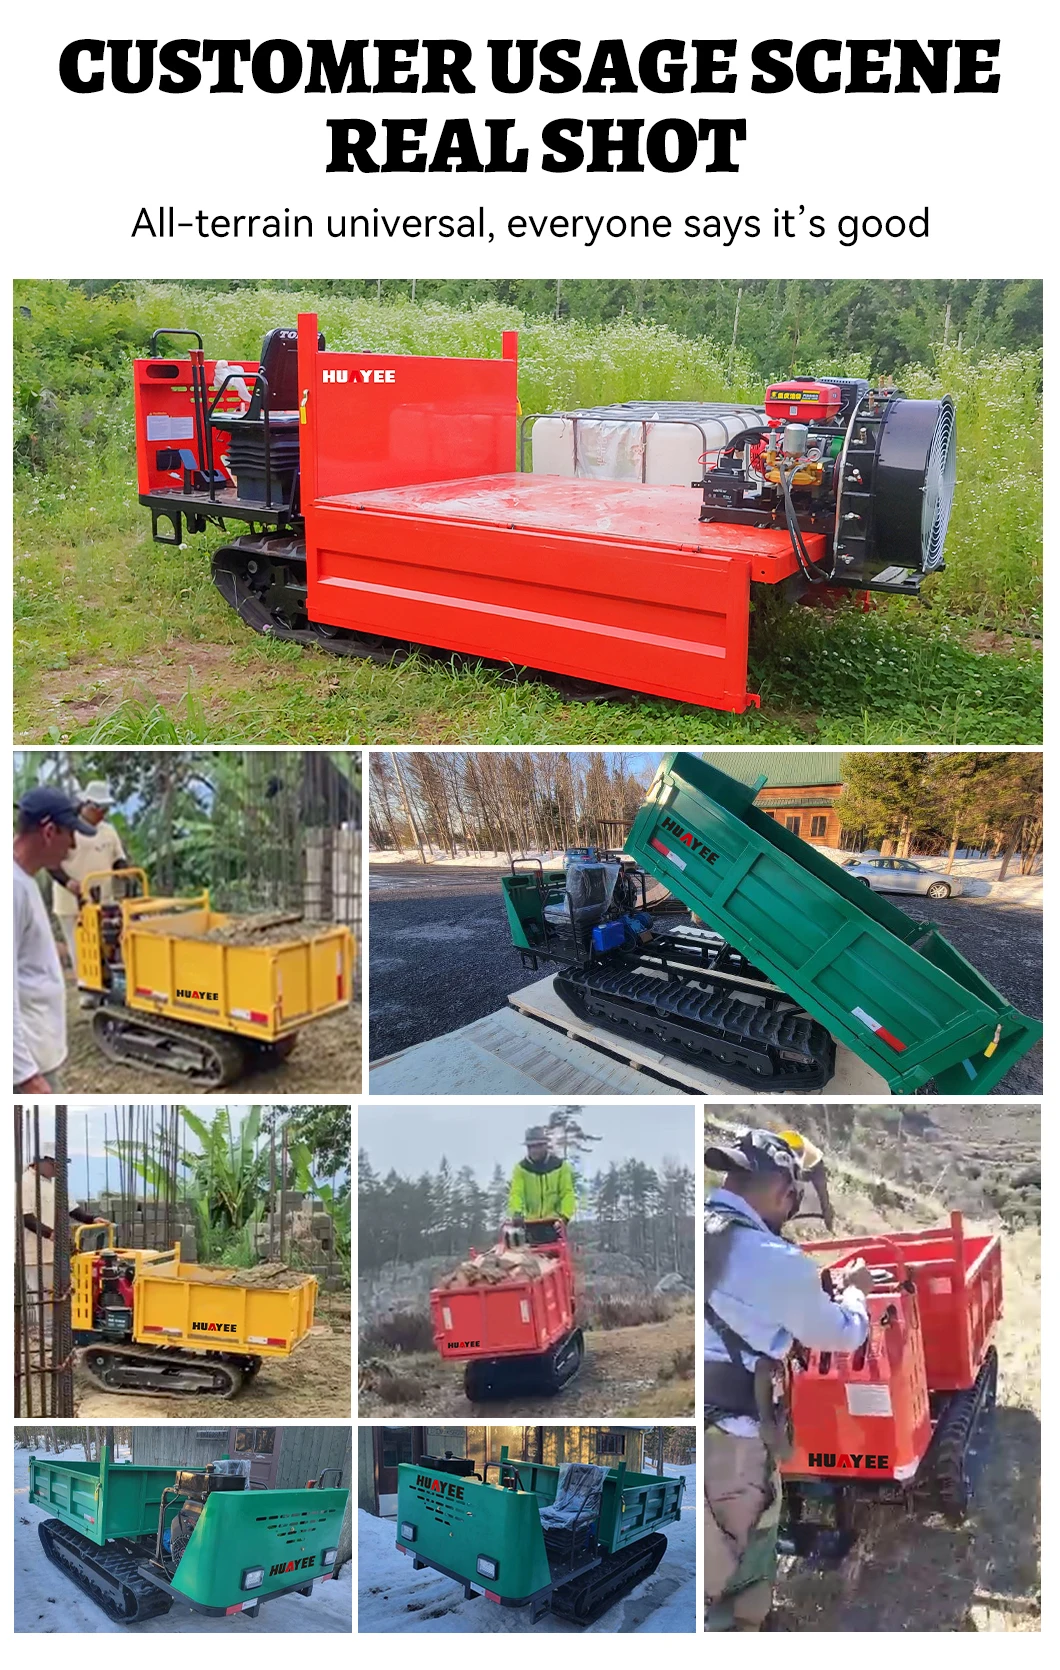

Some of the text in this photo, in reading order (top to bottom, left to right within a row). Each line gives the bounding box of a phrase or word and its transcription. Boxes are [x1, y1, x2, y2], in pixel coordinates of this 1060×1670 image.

[322, 369, 396, 383] HUAYEE
[661, 816, 720, 866] HUAYEE
[176, 989, 219, 1001] HUAYEE
[192, 1321, 237, 1333] HUAYEE
[447, 1340, 481, 1349] HUAYEE
[808, 1453, 889, 1469] HUAYEE
[416, 1474, 465, 1500] HUAYEE
[268, 1555, 316, 1577] HUAYEE
